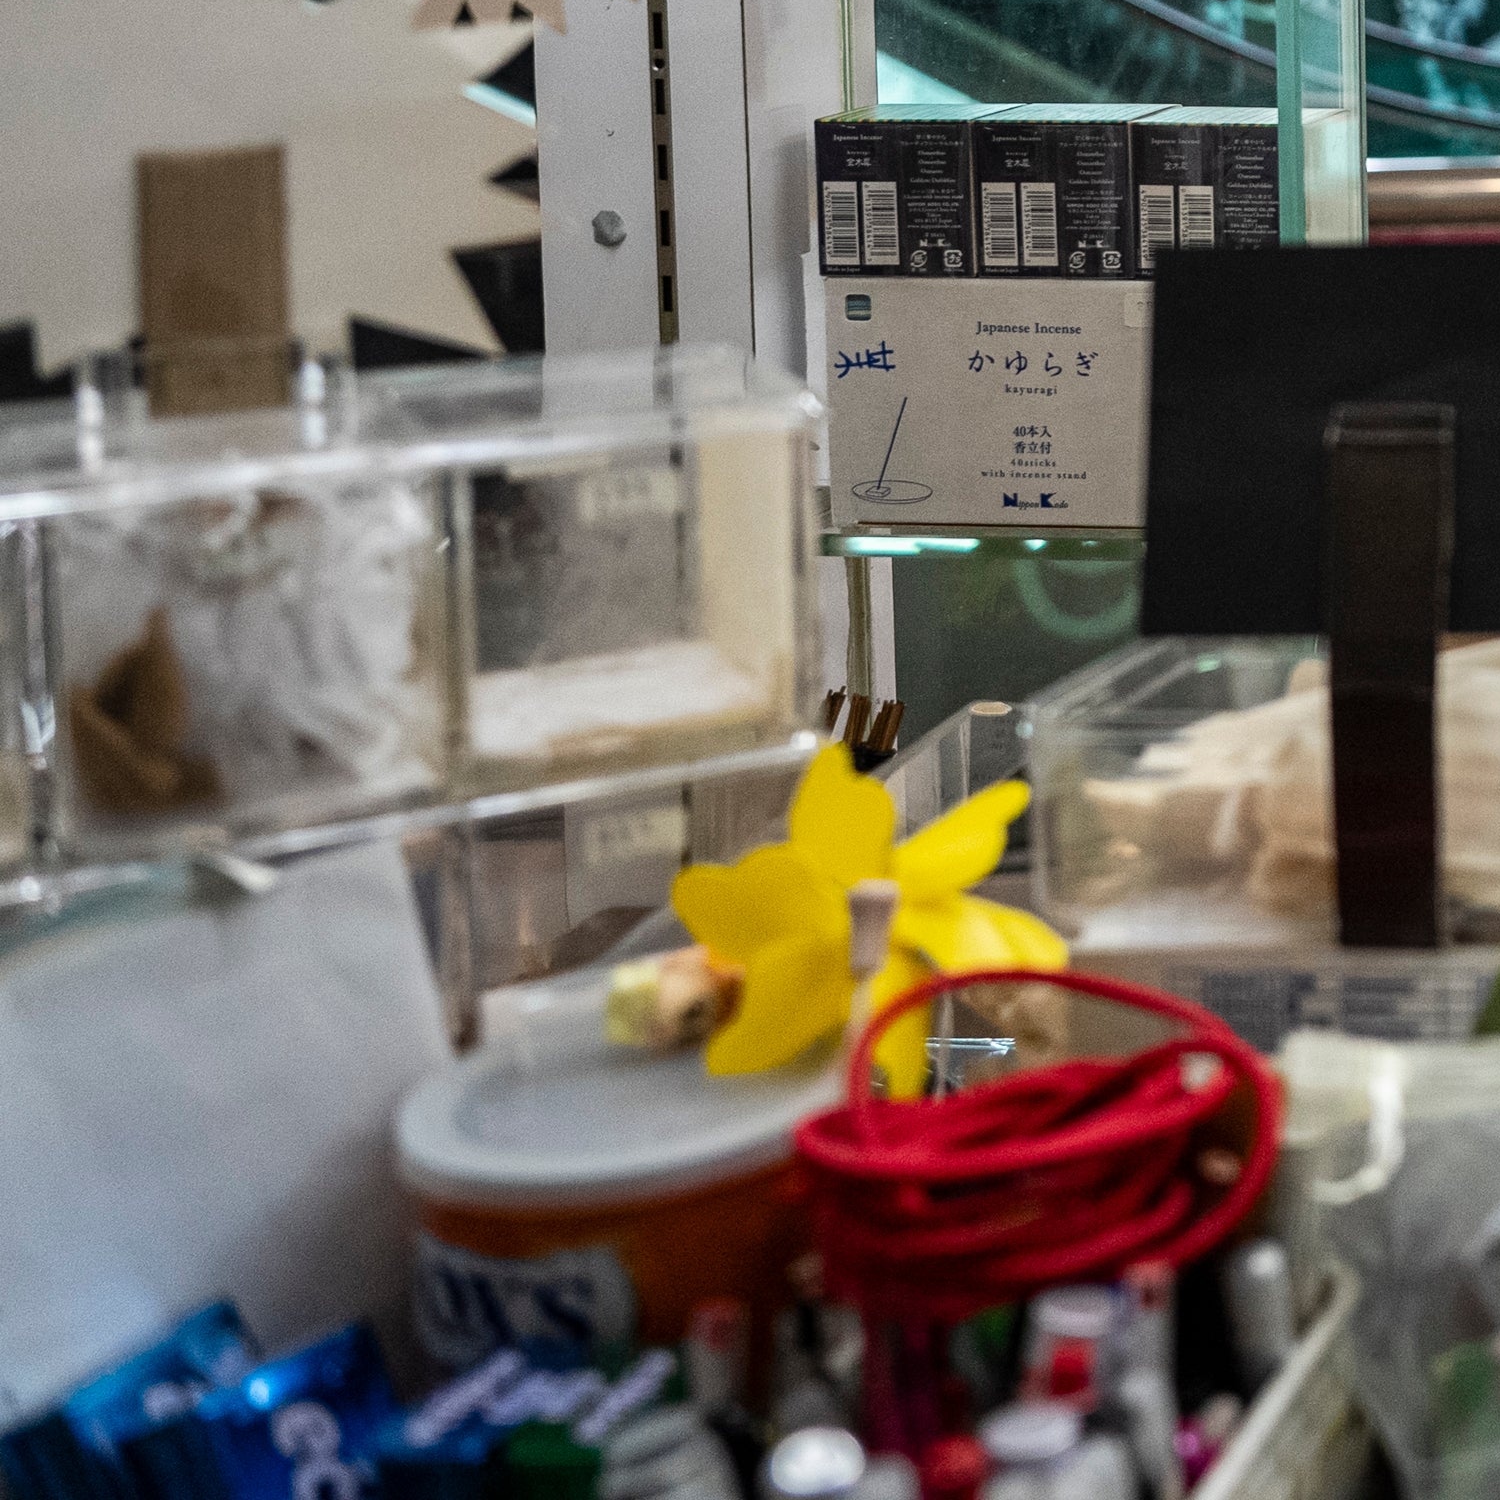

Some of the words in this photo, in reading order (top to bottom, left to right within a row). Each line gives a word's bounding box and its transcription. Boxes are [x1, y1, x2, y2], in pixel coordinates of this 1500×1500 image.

[975, 321, 1030, 335] Japanese
[1034, 322, 1082, 335] Incense
[967, 349, 1099, 377] かゆらぎ
[1004, 384, 1058, 396] kayuragi
[1012, 425, 1053, 439] 40本入
[1013, 441, 1053, 455] 香立付
[1010, 458, 1056, 468] 40sticks
[981, 470, 1006, 480] with
[1009, 470, 1052, 480] incense
[1056, 470, 1087, 480] stand
[1002, 492, 1039, 510] Nippon
[1040, 492, 1069, 509] Kodo
